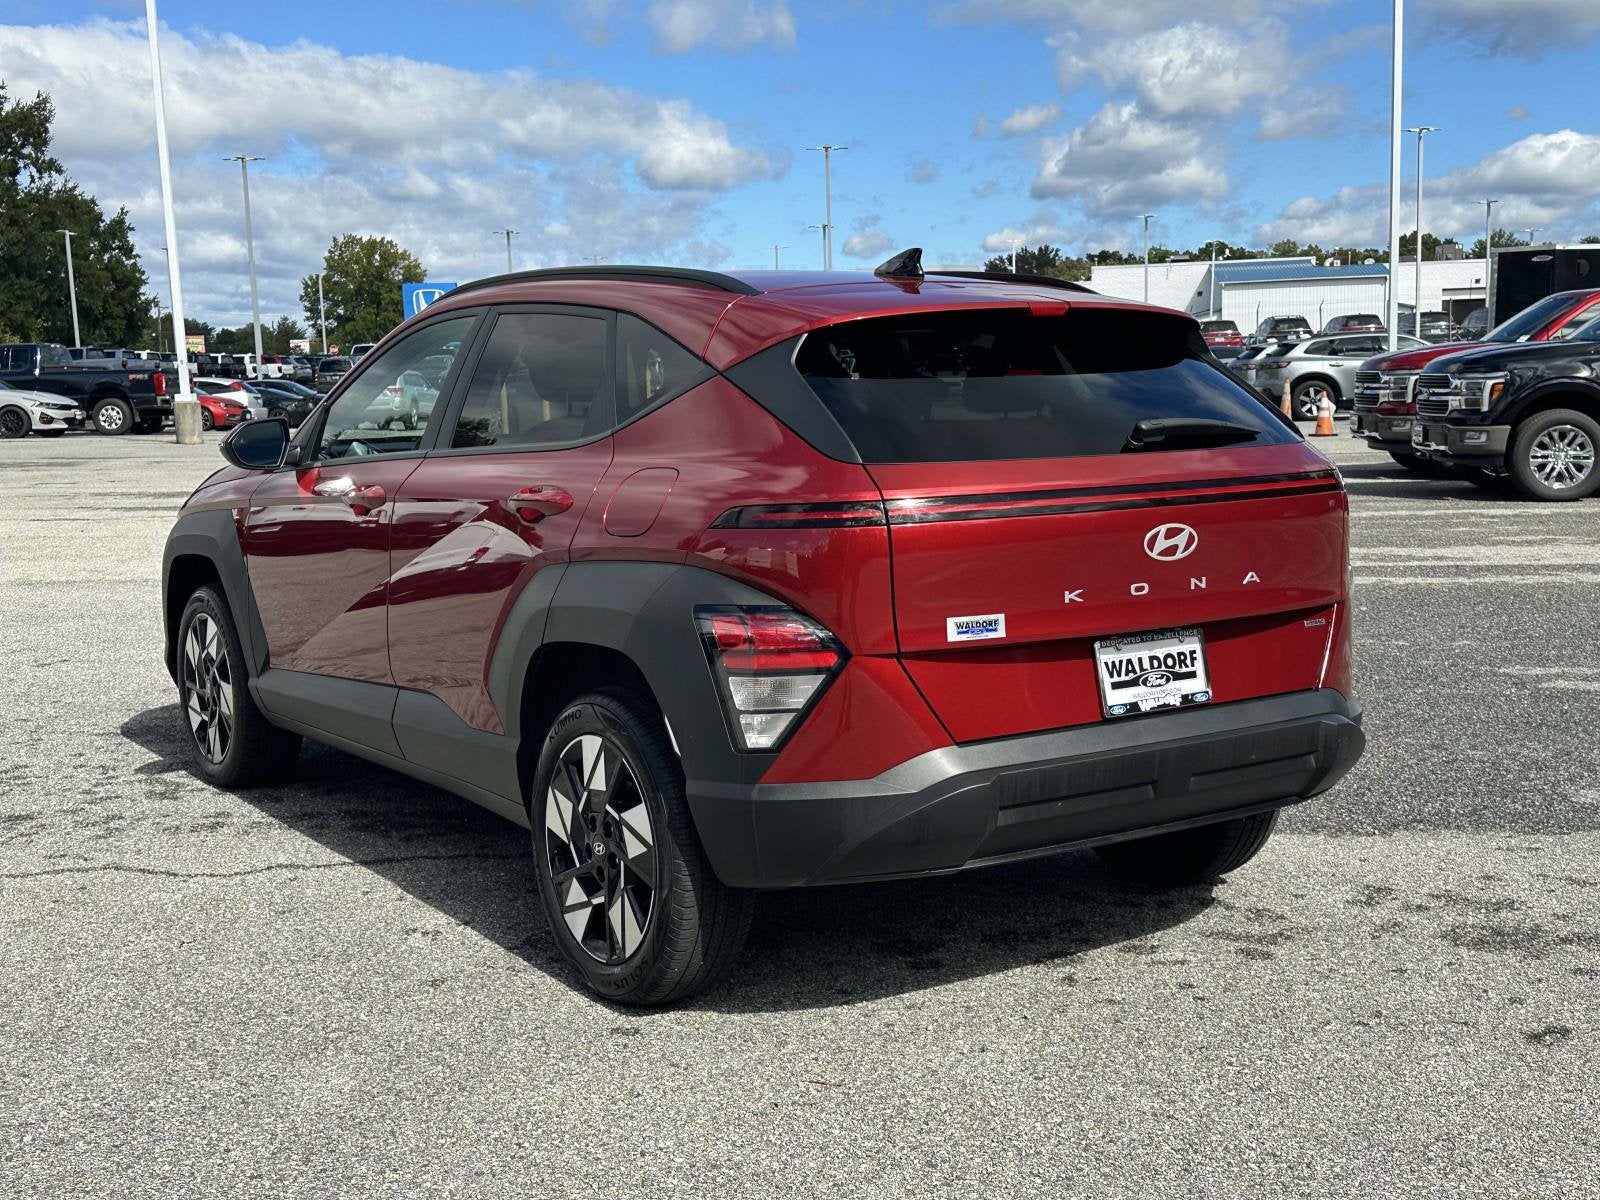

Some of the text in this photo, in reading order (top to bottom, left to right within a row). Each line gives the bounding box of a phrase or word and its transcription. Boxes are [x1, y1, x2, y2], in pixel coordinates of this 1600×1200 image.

[1064, 571, 1261, 604] KONA
[955, 619, 999, 630] WALDORF
[1101, 636, 1141, 647] DEDICATED
[1104, 649, 1198, 679] WALDORF
[1145, 673, 1168, 687] Ford
[548, 709, 582, 744] KUMHO
